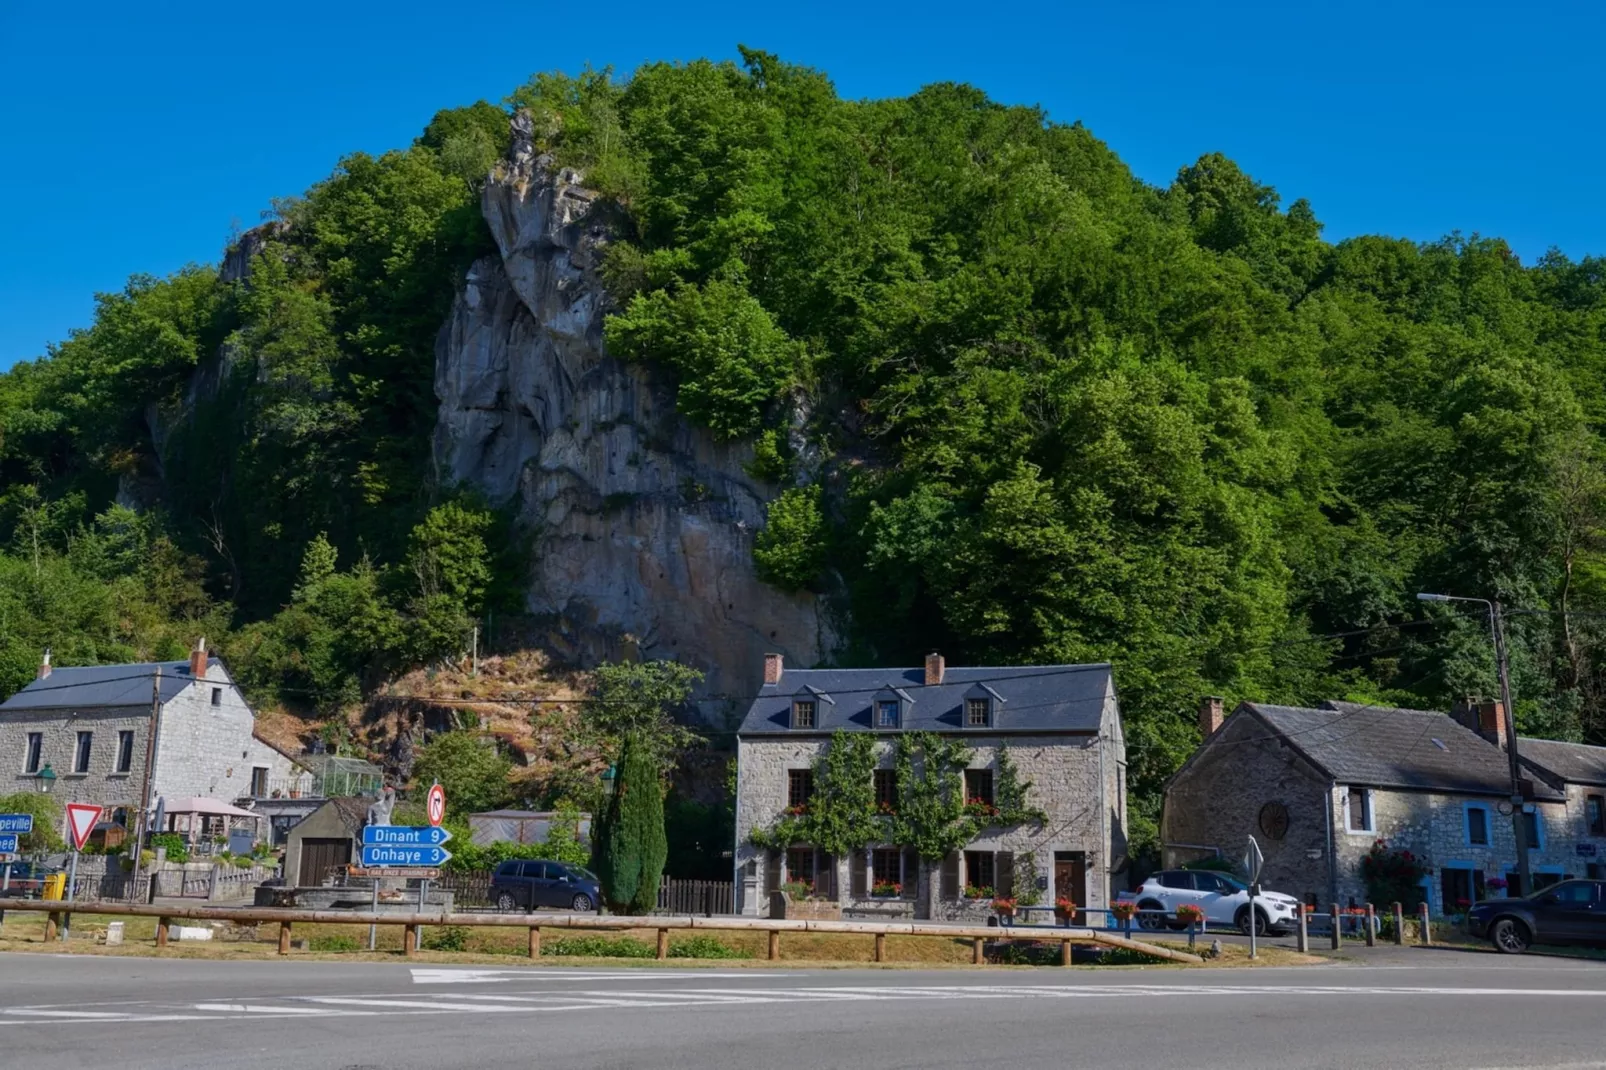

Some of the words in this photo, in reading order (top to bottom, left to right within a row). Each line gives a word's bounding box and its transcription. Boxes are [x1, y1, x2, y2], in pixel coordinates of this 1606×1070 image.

[375, 829, 420, 842] Dinant
[431, 829, 440, 842] 9
[371, 849, 421, 863] Onhaye
[431, 849, 439, 861] 3
